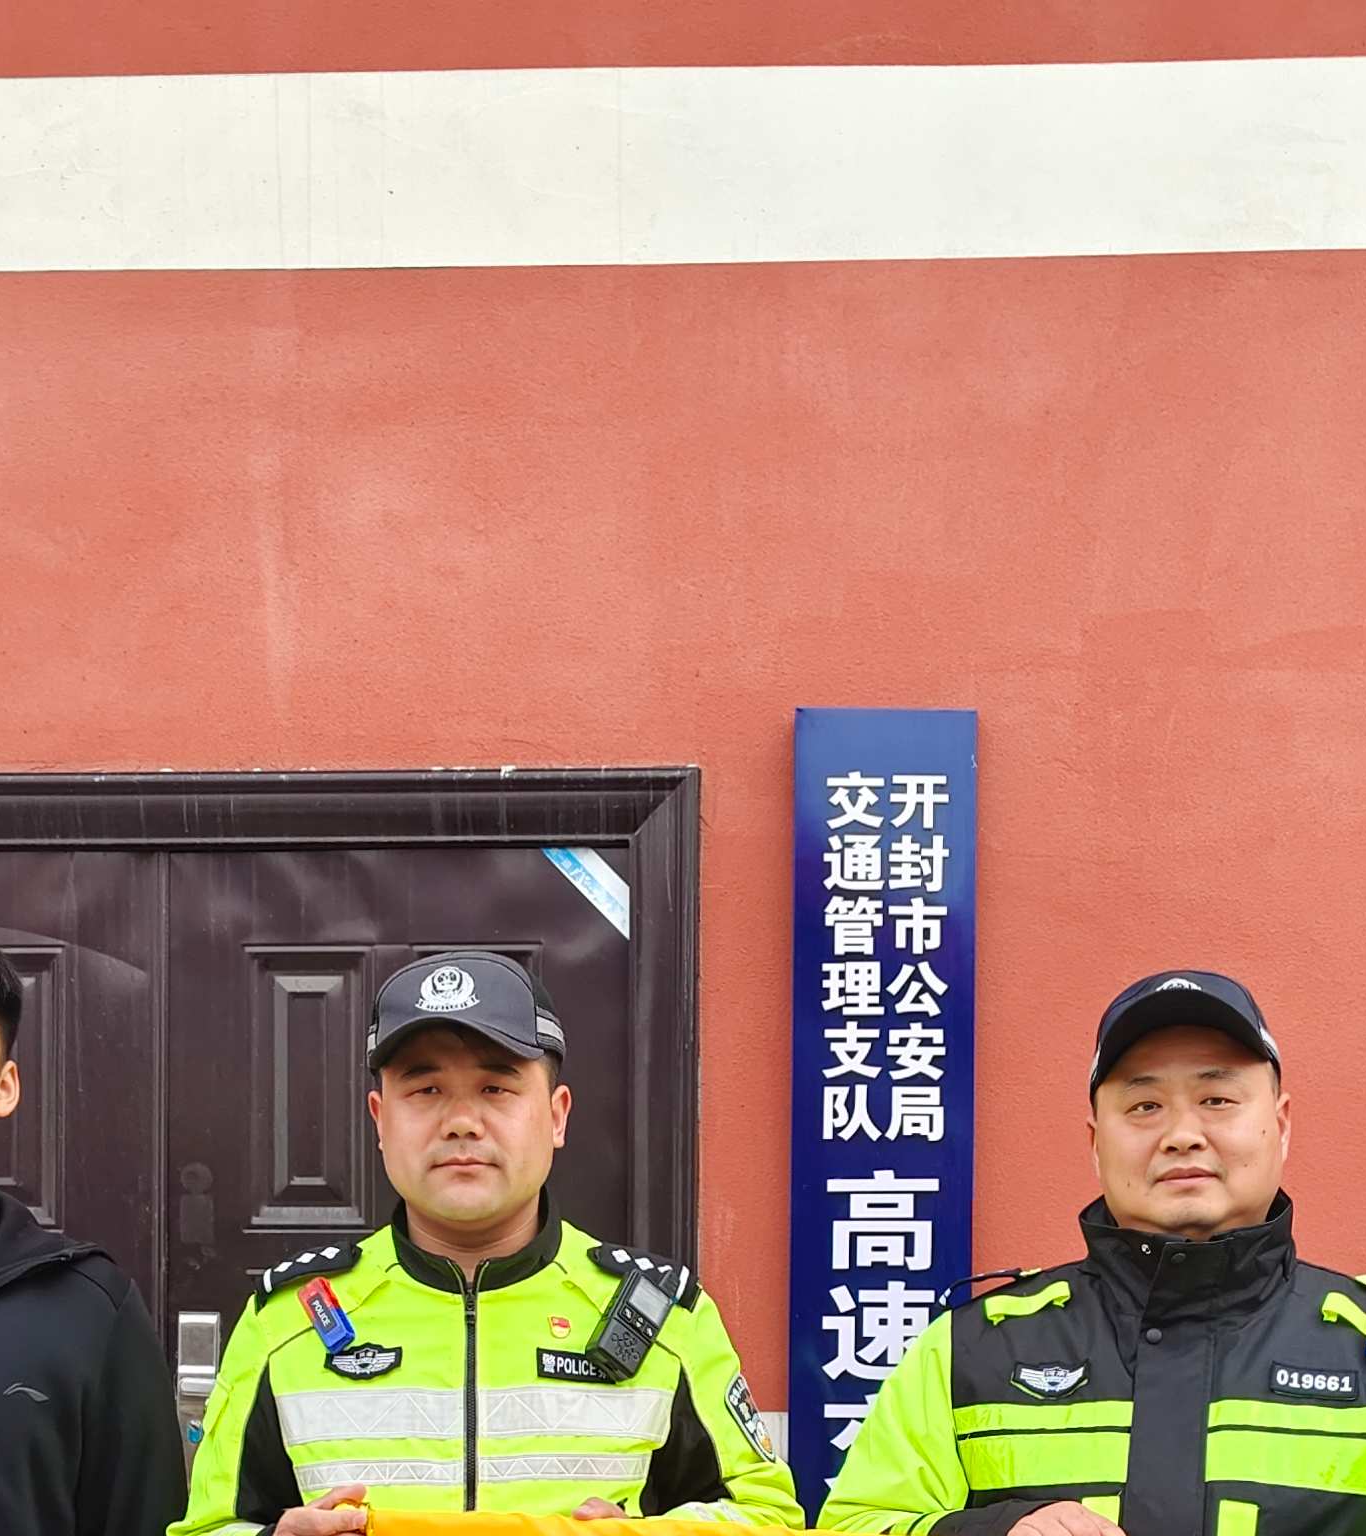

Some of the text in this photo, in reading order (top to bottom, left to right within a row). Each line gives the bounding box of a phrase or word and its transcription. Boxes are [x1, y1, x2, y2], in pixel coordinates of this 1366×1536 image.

[821, 772, 886, 1142] 交通管理支队
[885, 773, 951, 1142] 开封市公安局
[1276, 1369, 1352, 1392] 019661
